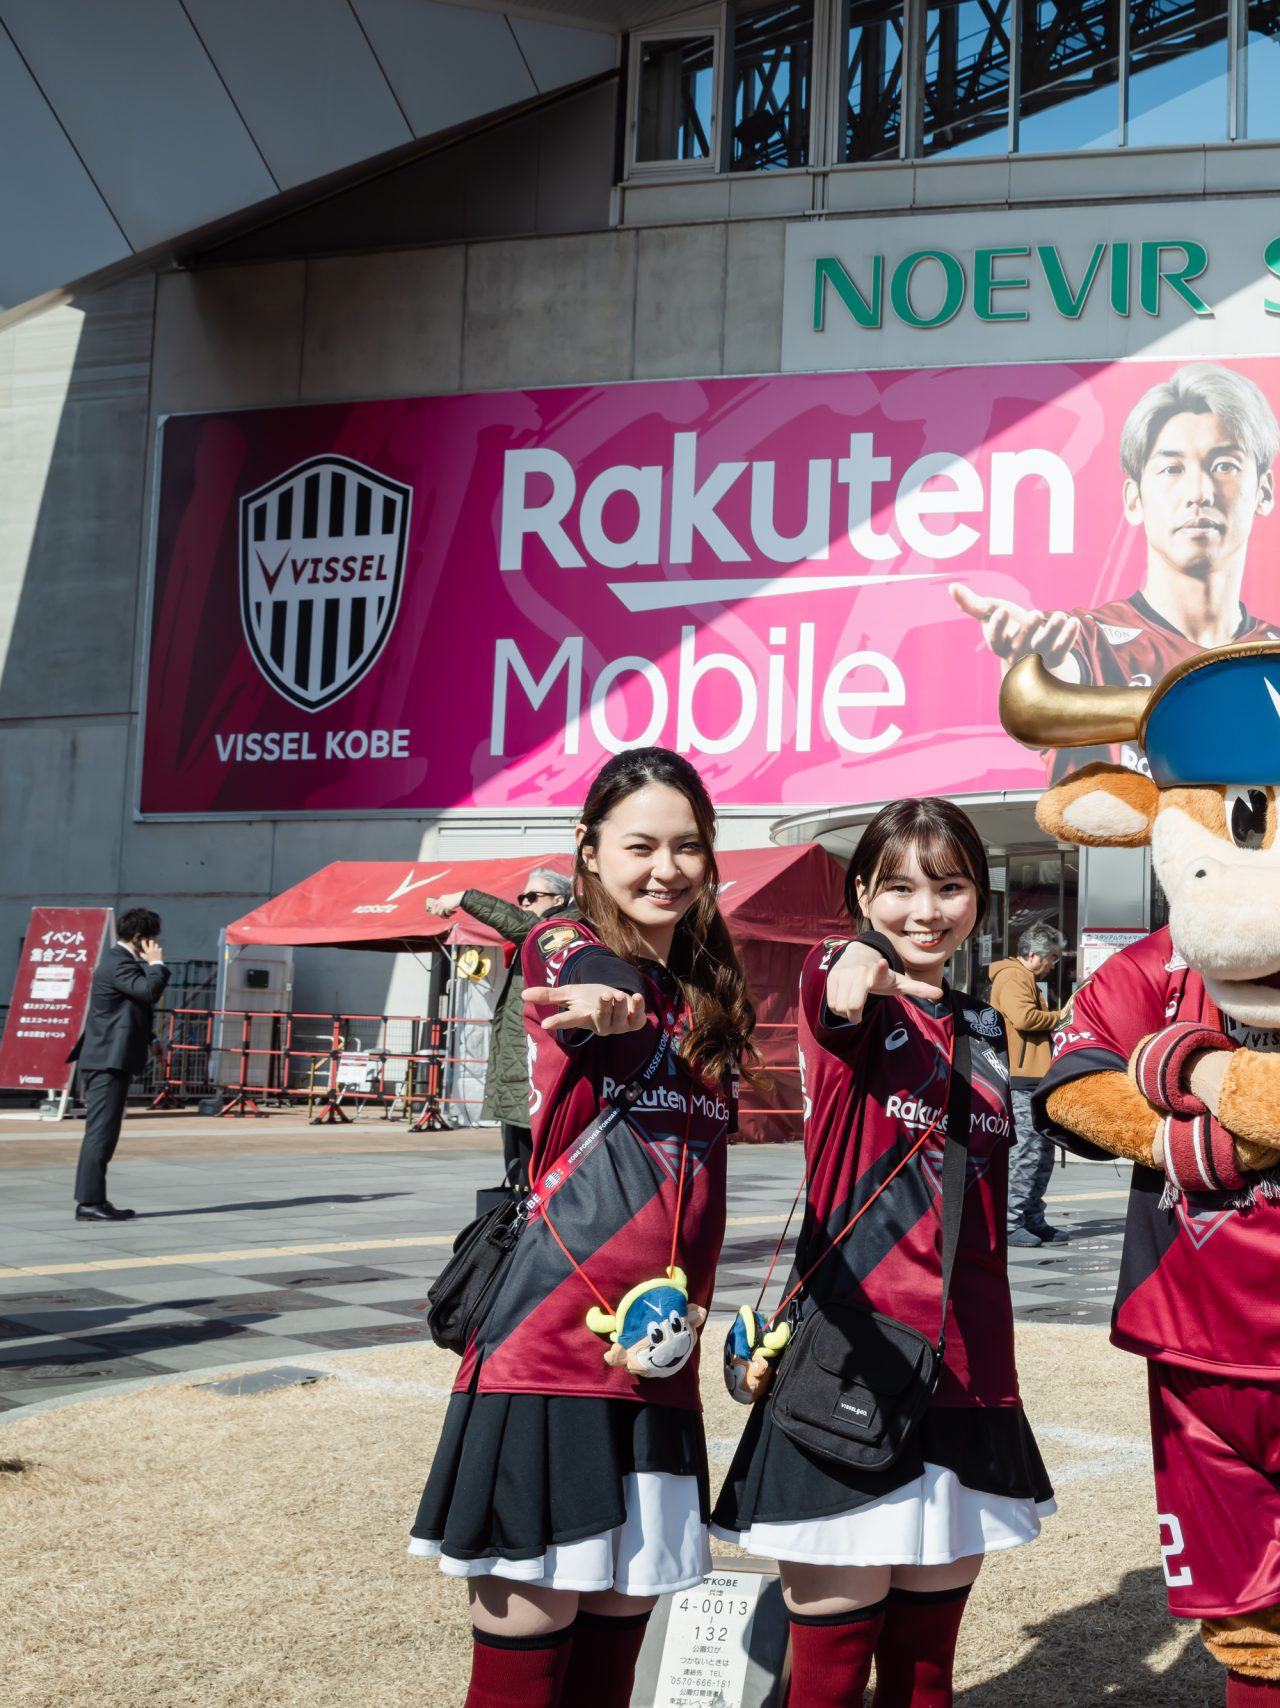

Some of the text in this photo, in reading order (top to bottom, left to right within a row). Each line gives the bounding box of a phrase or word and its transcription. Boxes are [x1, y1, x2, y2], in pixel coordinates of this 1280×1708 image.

[812, 238, 1215, 334] NOEVIR
[499, 431, 1075, 572] Rakuten
[290, 553, 389, 586] VISSEL
[488, 622, 906, 757] Mobile
[215, 728, 411, 763] VISSEL KOBE
[41, 931, 85, 945] イベント
[30, 948, 87, 962] 集合ブース
[711, 1578, 738, 1588] KOBE
[679, 1597, 748, 1616] 4-0013
[695, 1625, 728, 1642] 132
[692, 1645, 722, 1654] 公園灯が
[680, 1657, 729, 1667] つかないときは
[710, 1670, 722, 1678] TEL
